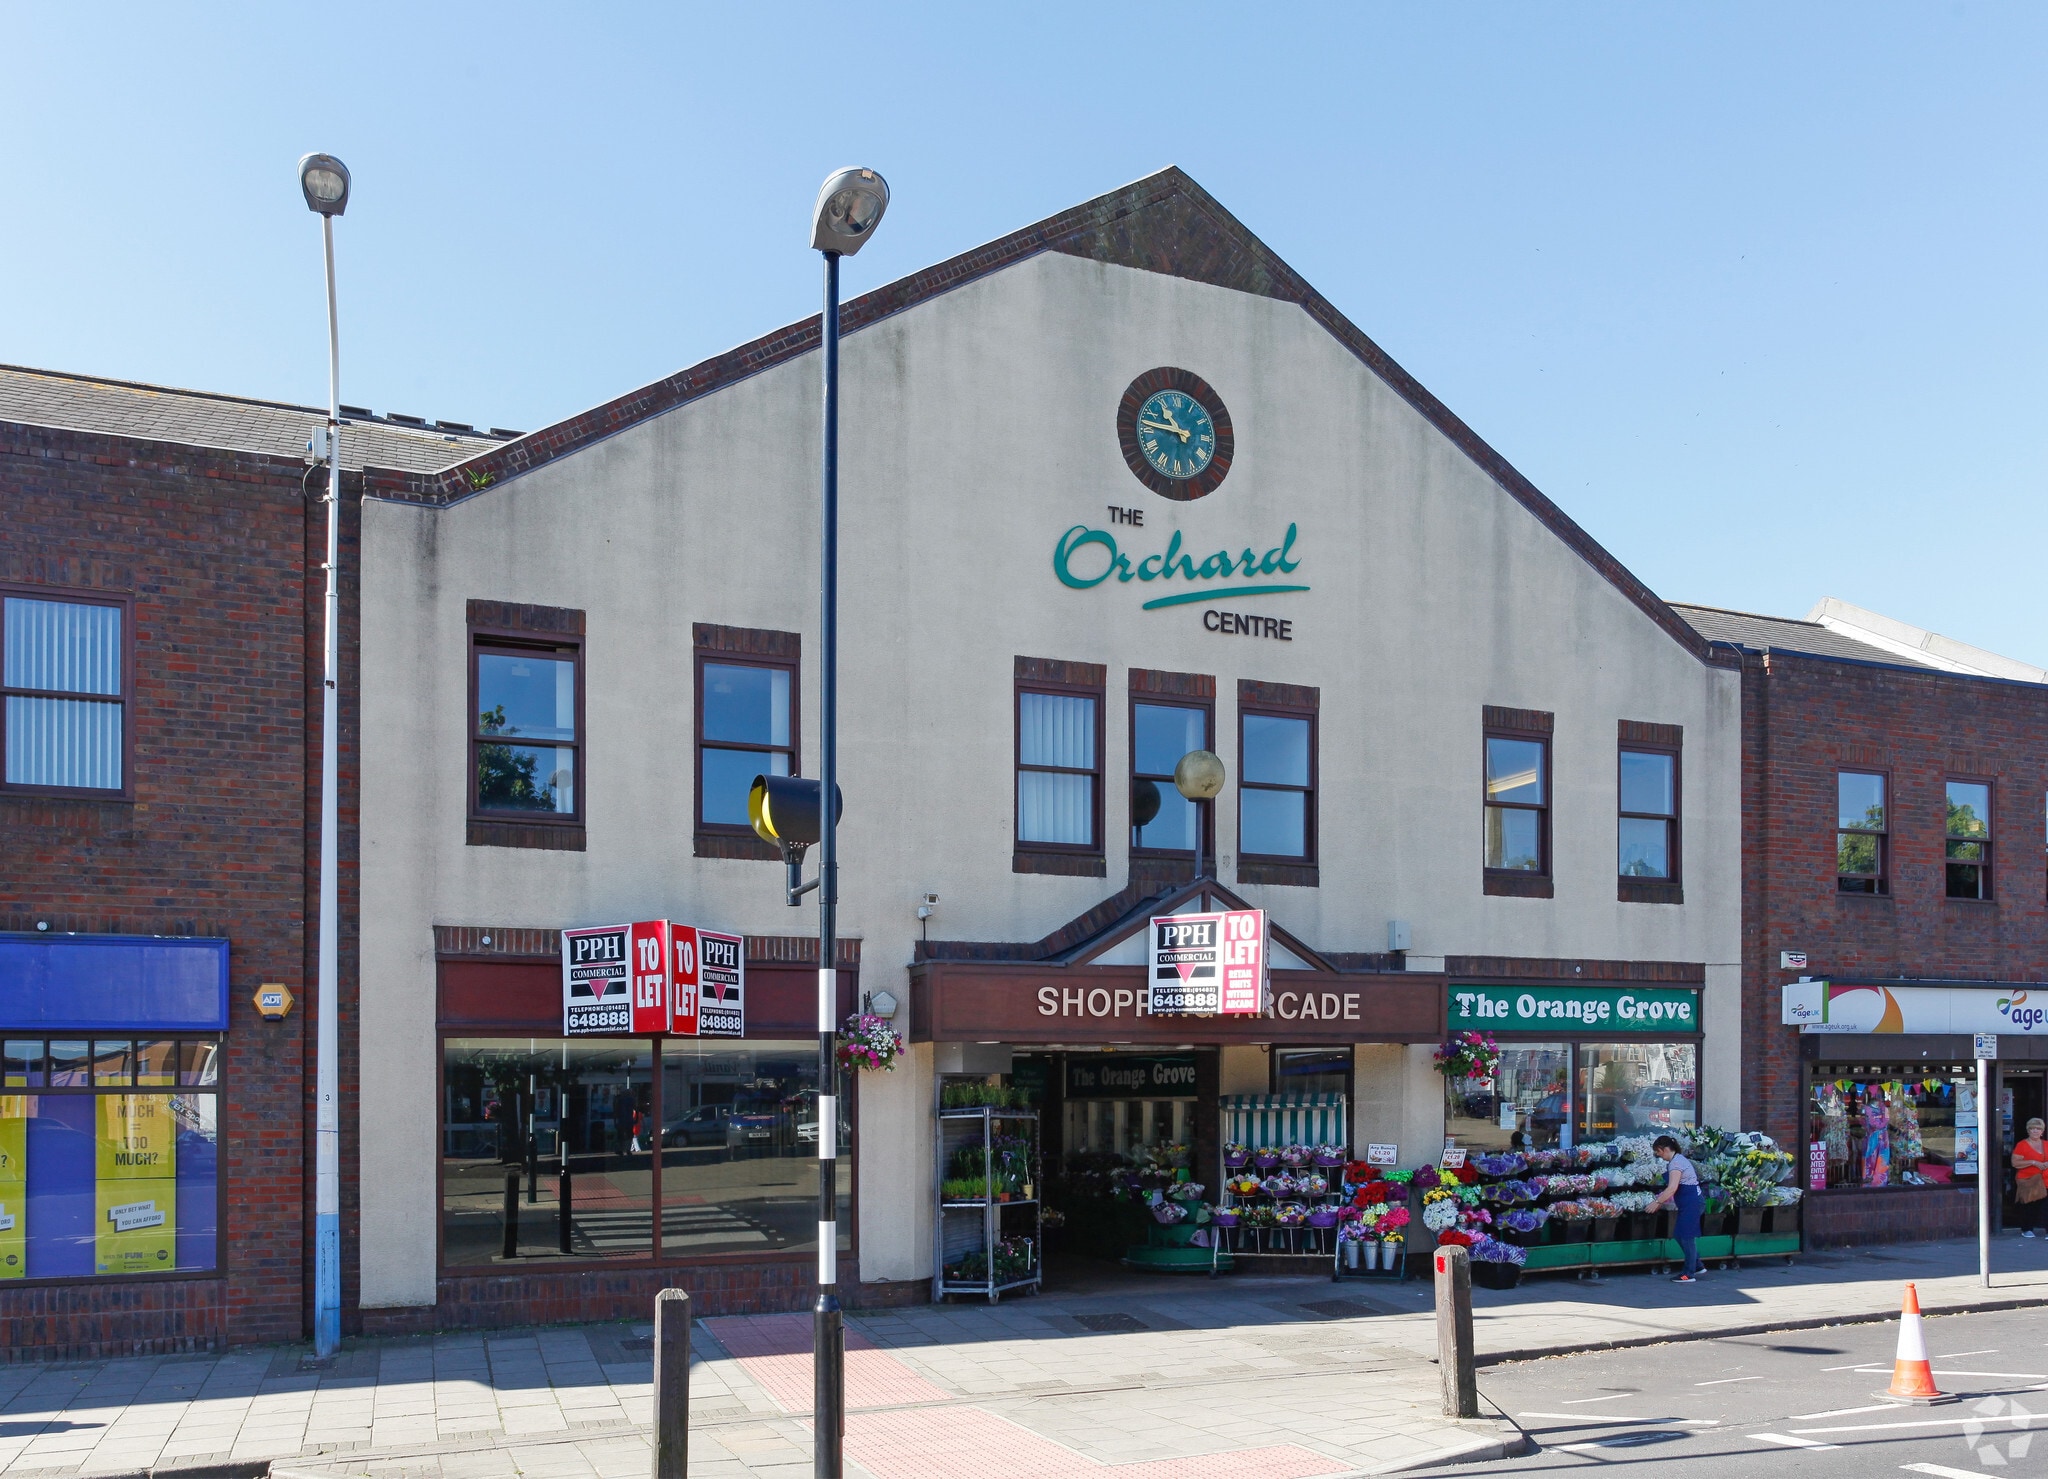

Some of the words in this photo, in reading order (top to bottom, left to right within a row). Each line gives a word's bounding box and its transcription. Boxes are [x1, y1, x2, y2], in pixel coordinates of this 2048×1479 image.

[1107, 505, 1144, 527] THE
[1053, 522, 1303, 589] Orchard
[1202, 609, 1293, 641] CENTRE
[1163, 923, 1211, 947] PPH
[1228, 914, 1255, 940] TO
[575, 935, 621, 962] PPH
[637, 937, 660, 971] TO
[676, 940, 694, 974] TO
[705, 941, 736, 966] PPH
[1159, 953, 1214, 963] COMMERCIAL
[1224, 940, 1259, 965] LET
[572, 968, 625, 980] COMMERCIAL
[703, 973, 738, 984] COMMERCIAL
[1228, 969, 1253, 979] RETAIL
[1229, 979, 1252, 989] UNITS
[262, 995, 281, 1004] ADT
[637, 974, 663, 1008] LET
[675, 983, 697, 1017] LET
[1153, 993, 1217, 1007] 648888
[568, 1011, 629, 1028] 648888
[1456, 993, 1509, 1017] The
[1516, 993, 1610, 1024] Orange
[1616, 995, 1691, 1020] Grove
[2012, 1008, 2043, 1031] age
[700, 1015, 742, 1030] 648888
[1073, 1066, 1095, 1087] The
[1101, 1065, 1146, 1090] Orange
[1153, 1063, 1196, 1085] Grove
[325, 1094, 330, 1102] 3
[117, 1105, 154, 1118] MUCH
[123, 1136, 148, 1150] TOO
[115, 1152, 158, 1166] MUCH?
[143, 1214, 162, 1223] AFFORD
